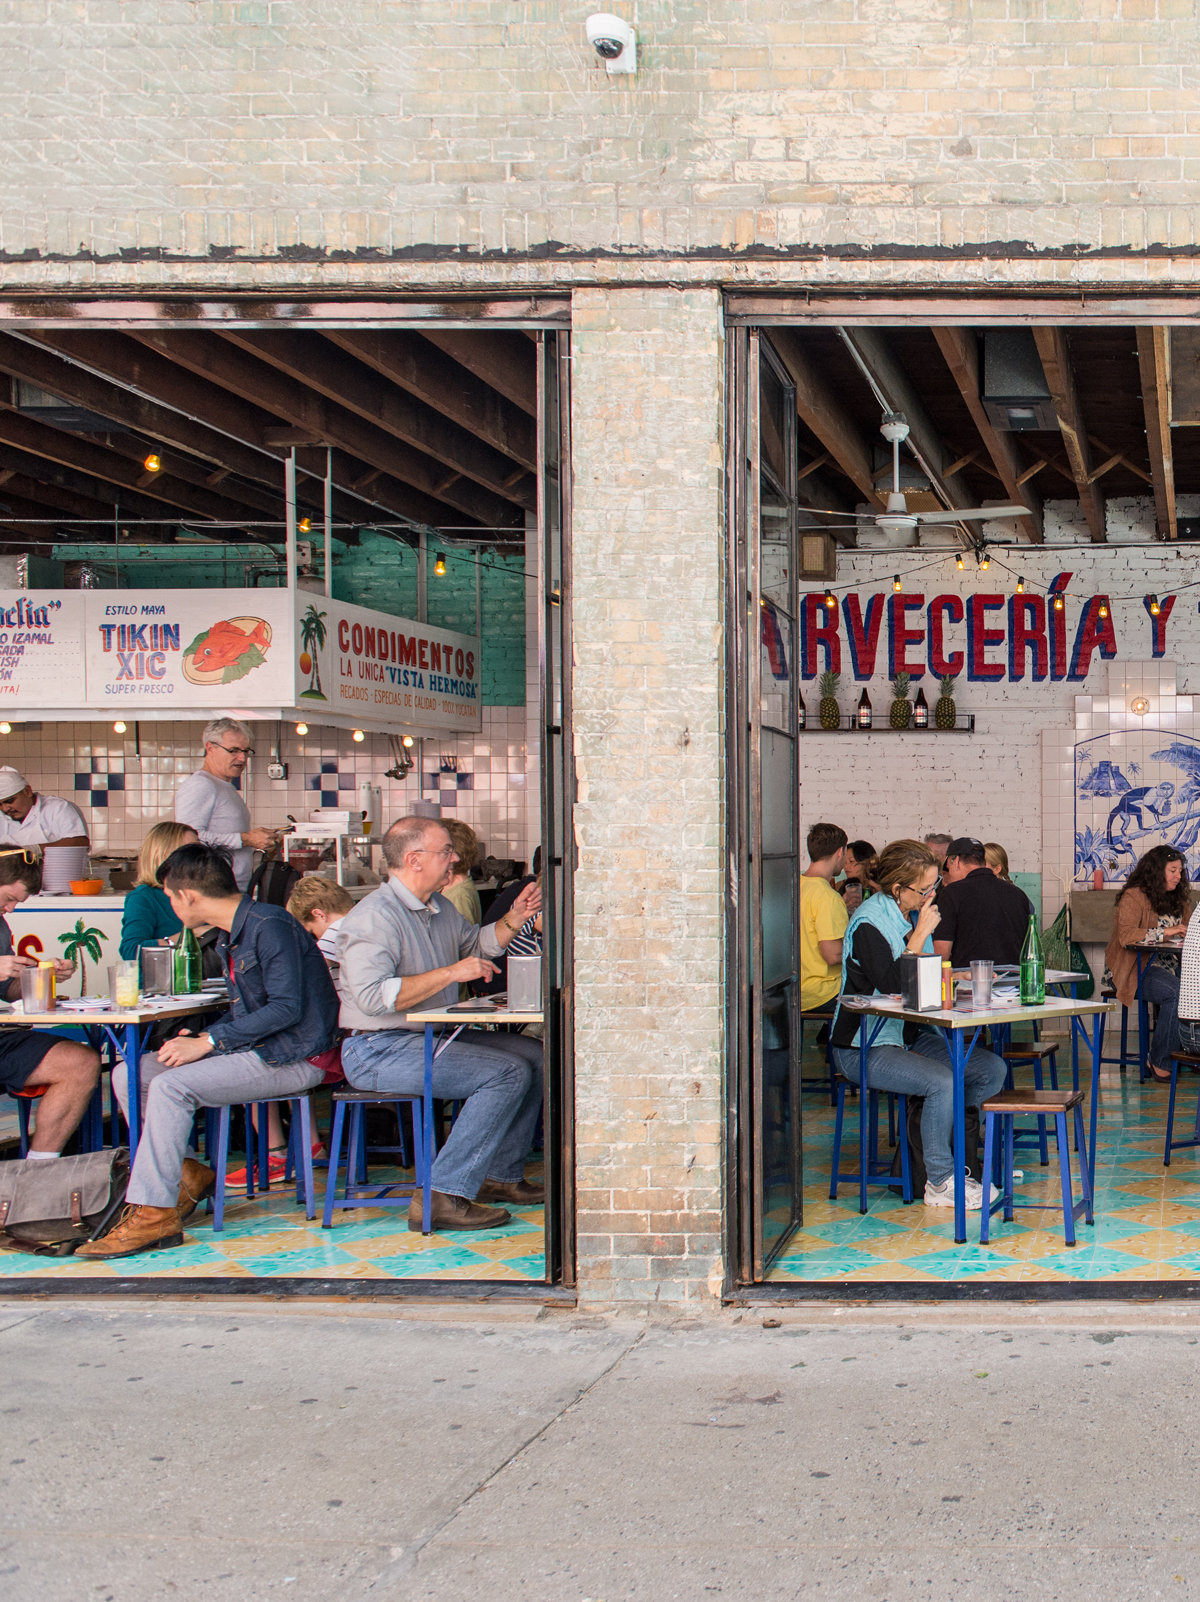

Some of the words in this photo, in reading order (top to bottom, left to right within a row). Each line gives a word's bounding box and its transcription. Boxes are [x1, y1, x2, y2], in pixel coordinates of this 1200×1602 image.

[105, 605, 138, 615] ESTILO
[141, 605, 166, 615] MAYA
[12, 633, 55, 645] IZAMAL
[99, 623, 180, 652] TIKIN
[1143, 594, 1177, 658] Y
[338, 619, 475, 680] CONDIMENTOS
[116, 652, 167, 681] XIC
[340, 657, 353, 678] LA
[359, 661, 385, 683] UNICA
[105, 684, 136, 694] SUPER
[138, 684, 174, 694] FRESCO
[340, 684, 369, 702] RECADOS
[374, 689, 402, 706] ESPECIAS
[404, 694, 413, 708] DE
[455, 703, 477, 718] YUCATAN
